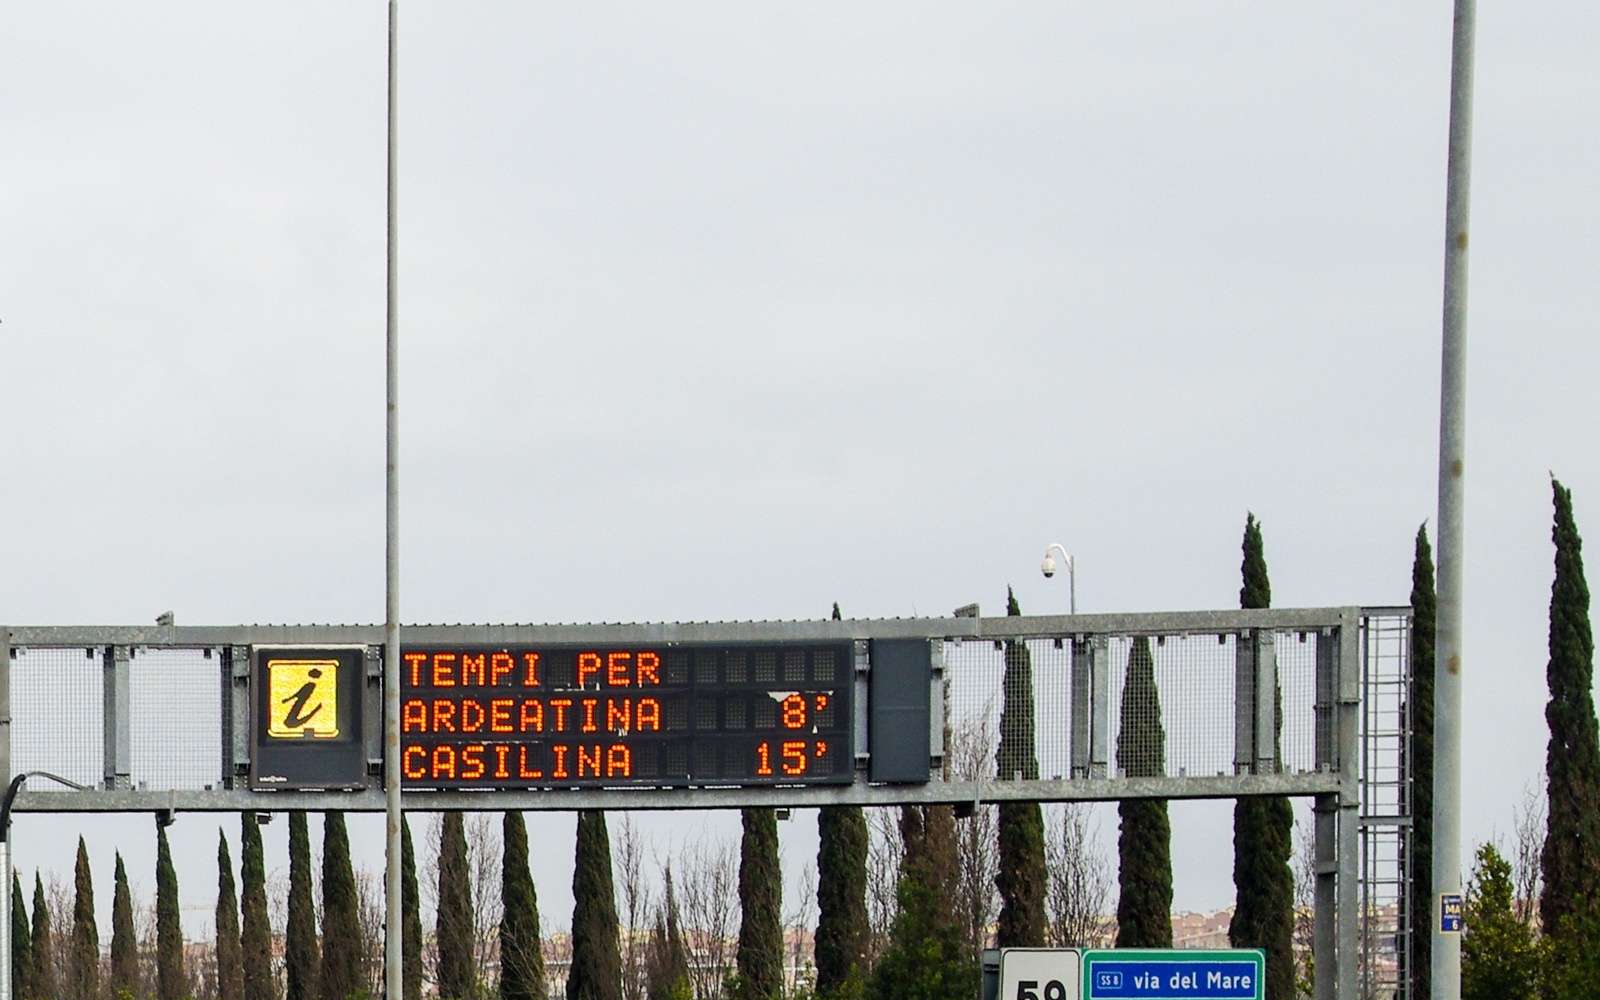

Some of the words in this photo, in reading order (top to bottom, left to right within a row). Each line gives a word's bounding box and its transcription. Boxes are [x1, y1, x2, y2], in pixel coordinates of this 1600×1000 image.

[404, 652, 541, 687] TEMPI
[578, 651, 660, 686] PER
[403, 698, 661, 733] ARDEATINA
[403, 744, 632, 779] CASILINA
[1101, 975, 1111, 986] SS
[1134, 972, 1160, 989] via
[1169, 972, 1198, 989] del
[1207, 971, 1252, 989] Mare
